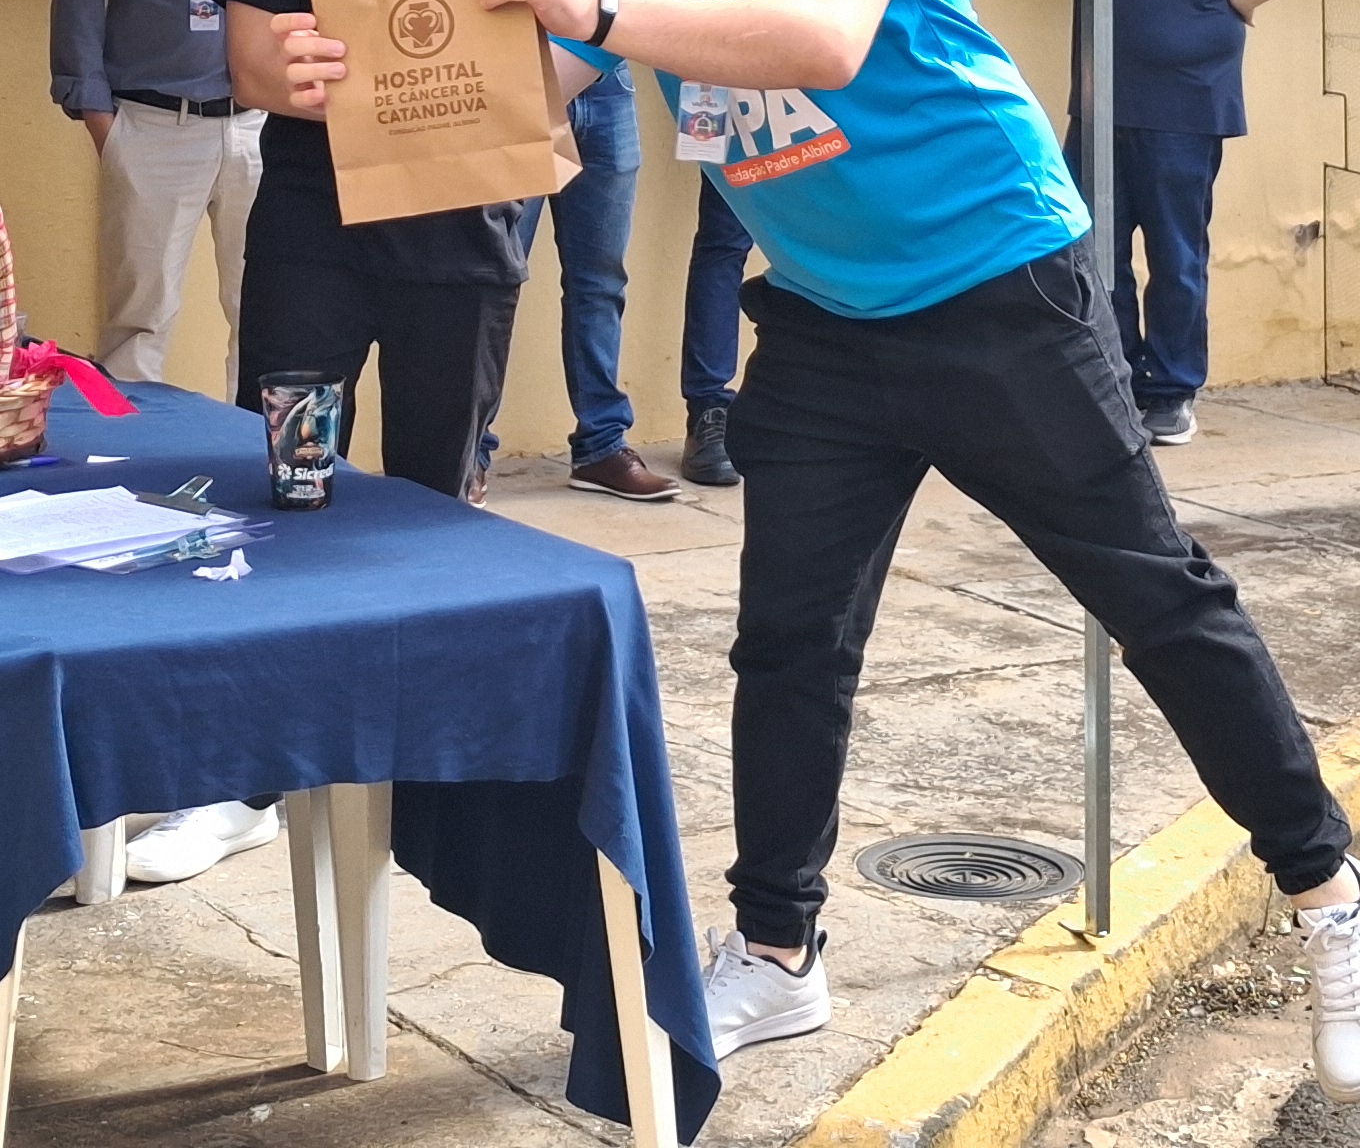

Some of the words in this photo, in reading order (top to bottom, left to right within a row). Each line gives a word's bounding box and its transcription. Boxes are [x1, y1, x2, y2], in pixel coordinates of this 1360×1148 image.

[374, 60, 484, 92] HOSPITAL
[374, 93, 394, 108] DE
[398, 84, 460, 104] CÂNCER
[464, 80, 486, 95] DE
[377, 96, 489, 125] CATANDUVA
[726, 87, 838, 158] PA
[765, 150, 800, 174] Padre
[800, 139, 842, 163] Albino
